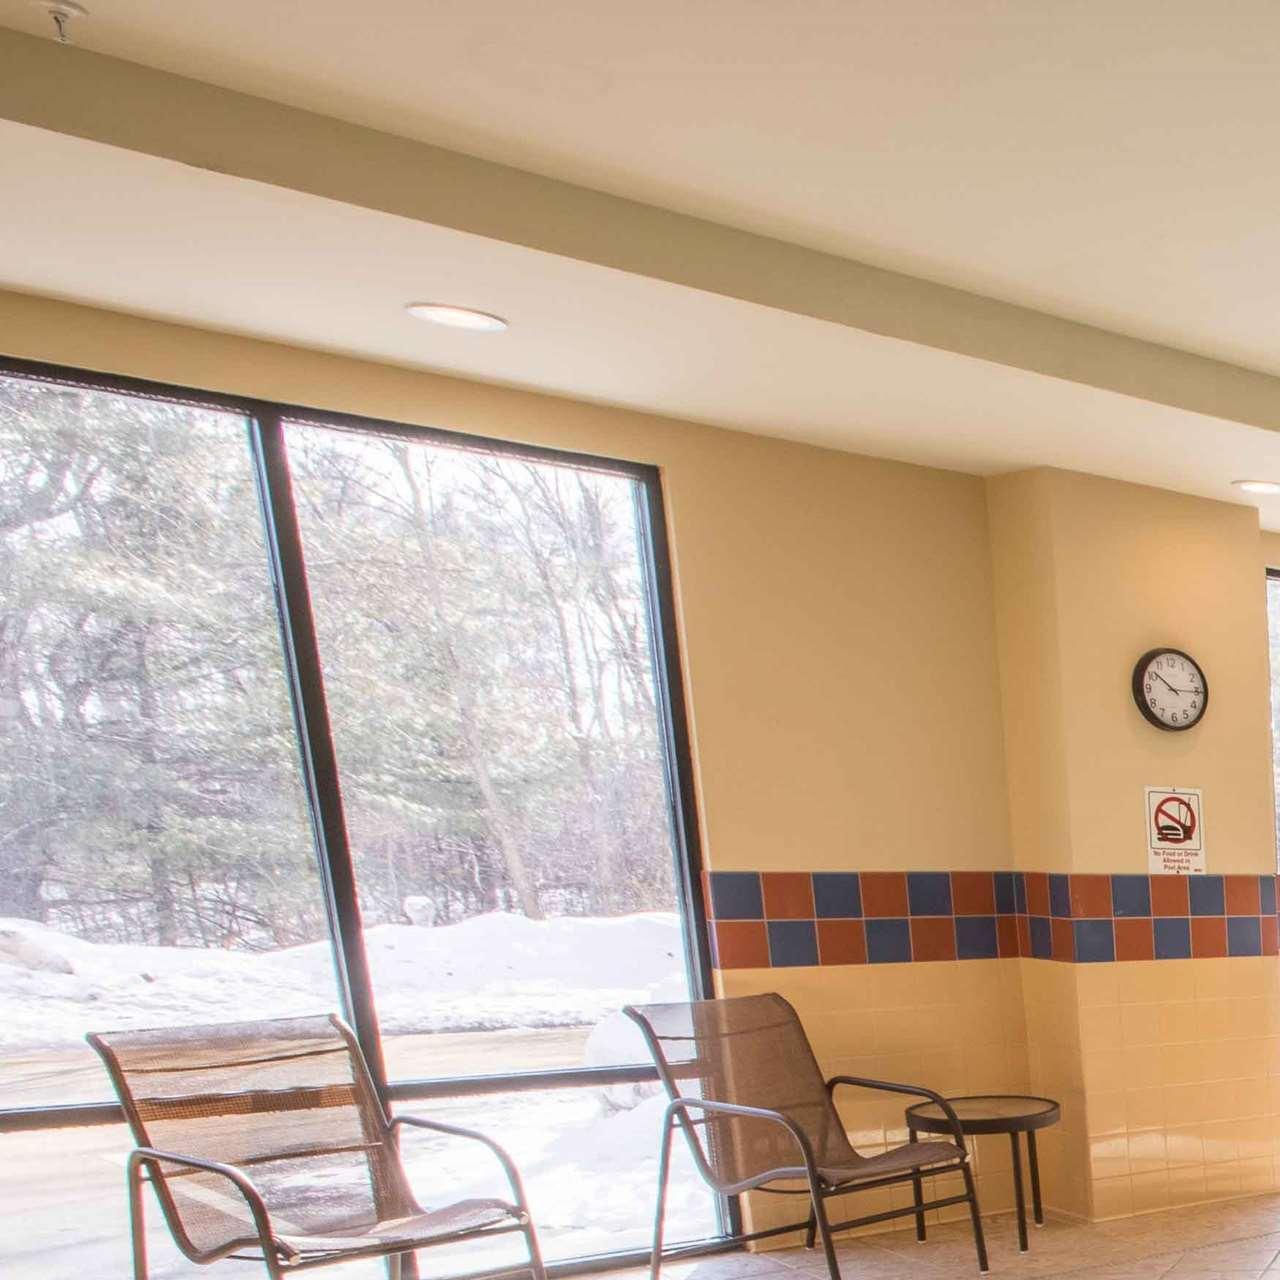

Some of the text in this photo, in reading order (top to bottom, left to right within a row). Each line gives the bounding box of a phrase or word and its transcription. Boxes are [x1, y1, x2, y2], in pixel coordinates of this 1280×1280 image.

[1166, 657, 1176, 668] 12
[1145, 683, 1152, 693] 9
[1150, 698, 1157, 708] 8
[1159, 707, 1165, 717] 7
[1171, 712, 1178, 722] 6
[1182, 710, 1189, 719] 5
